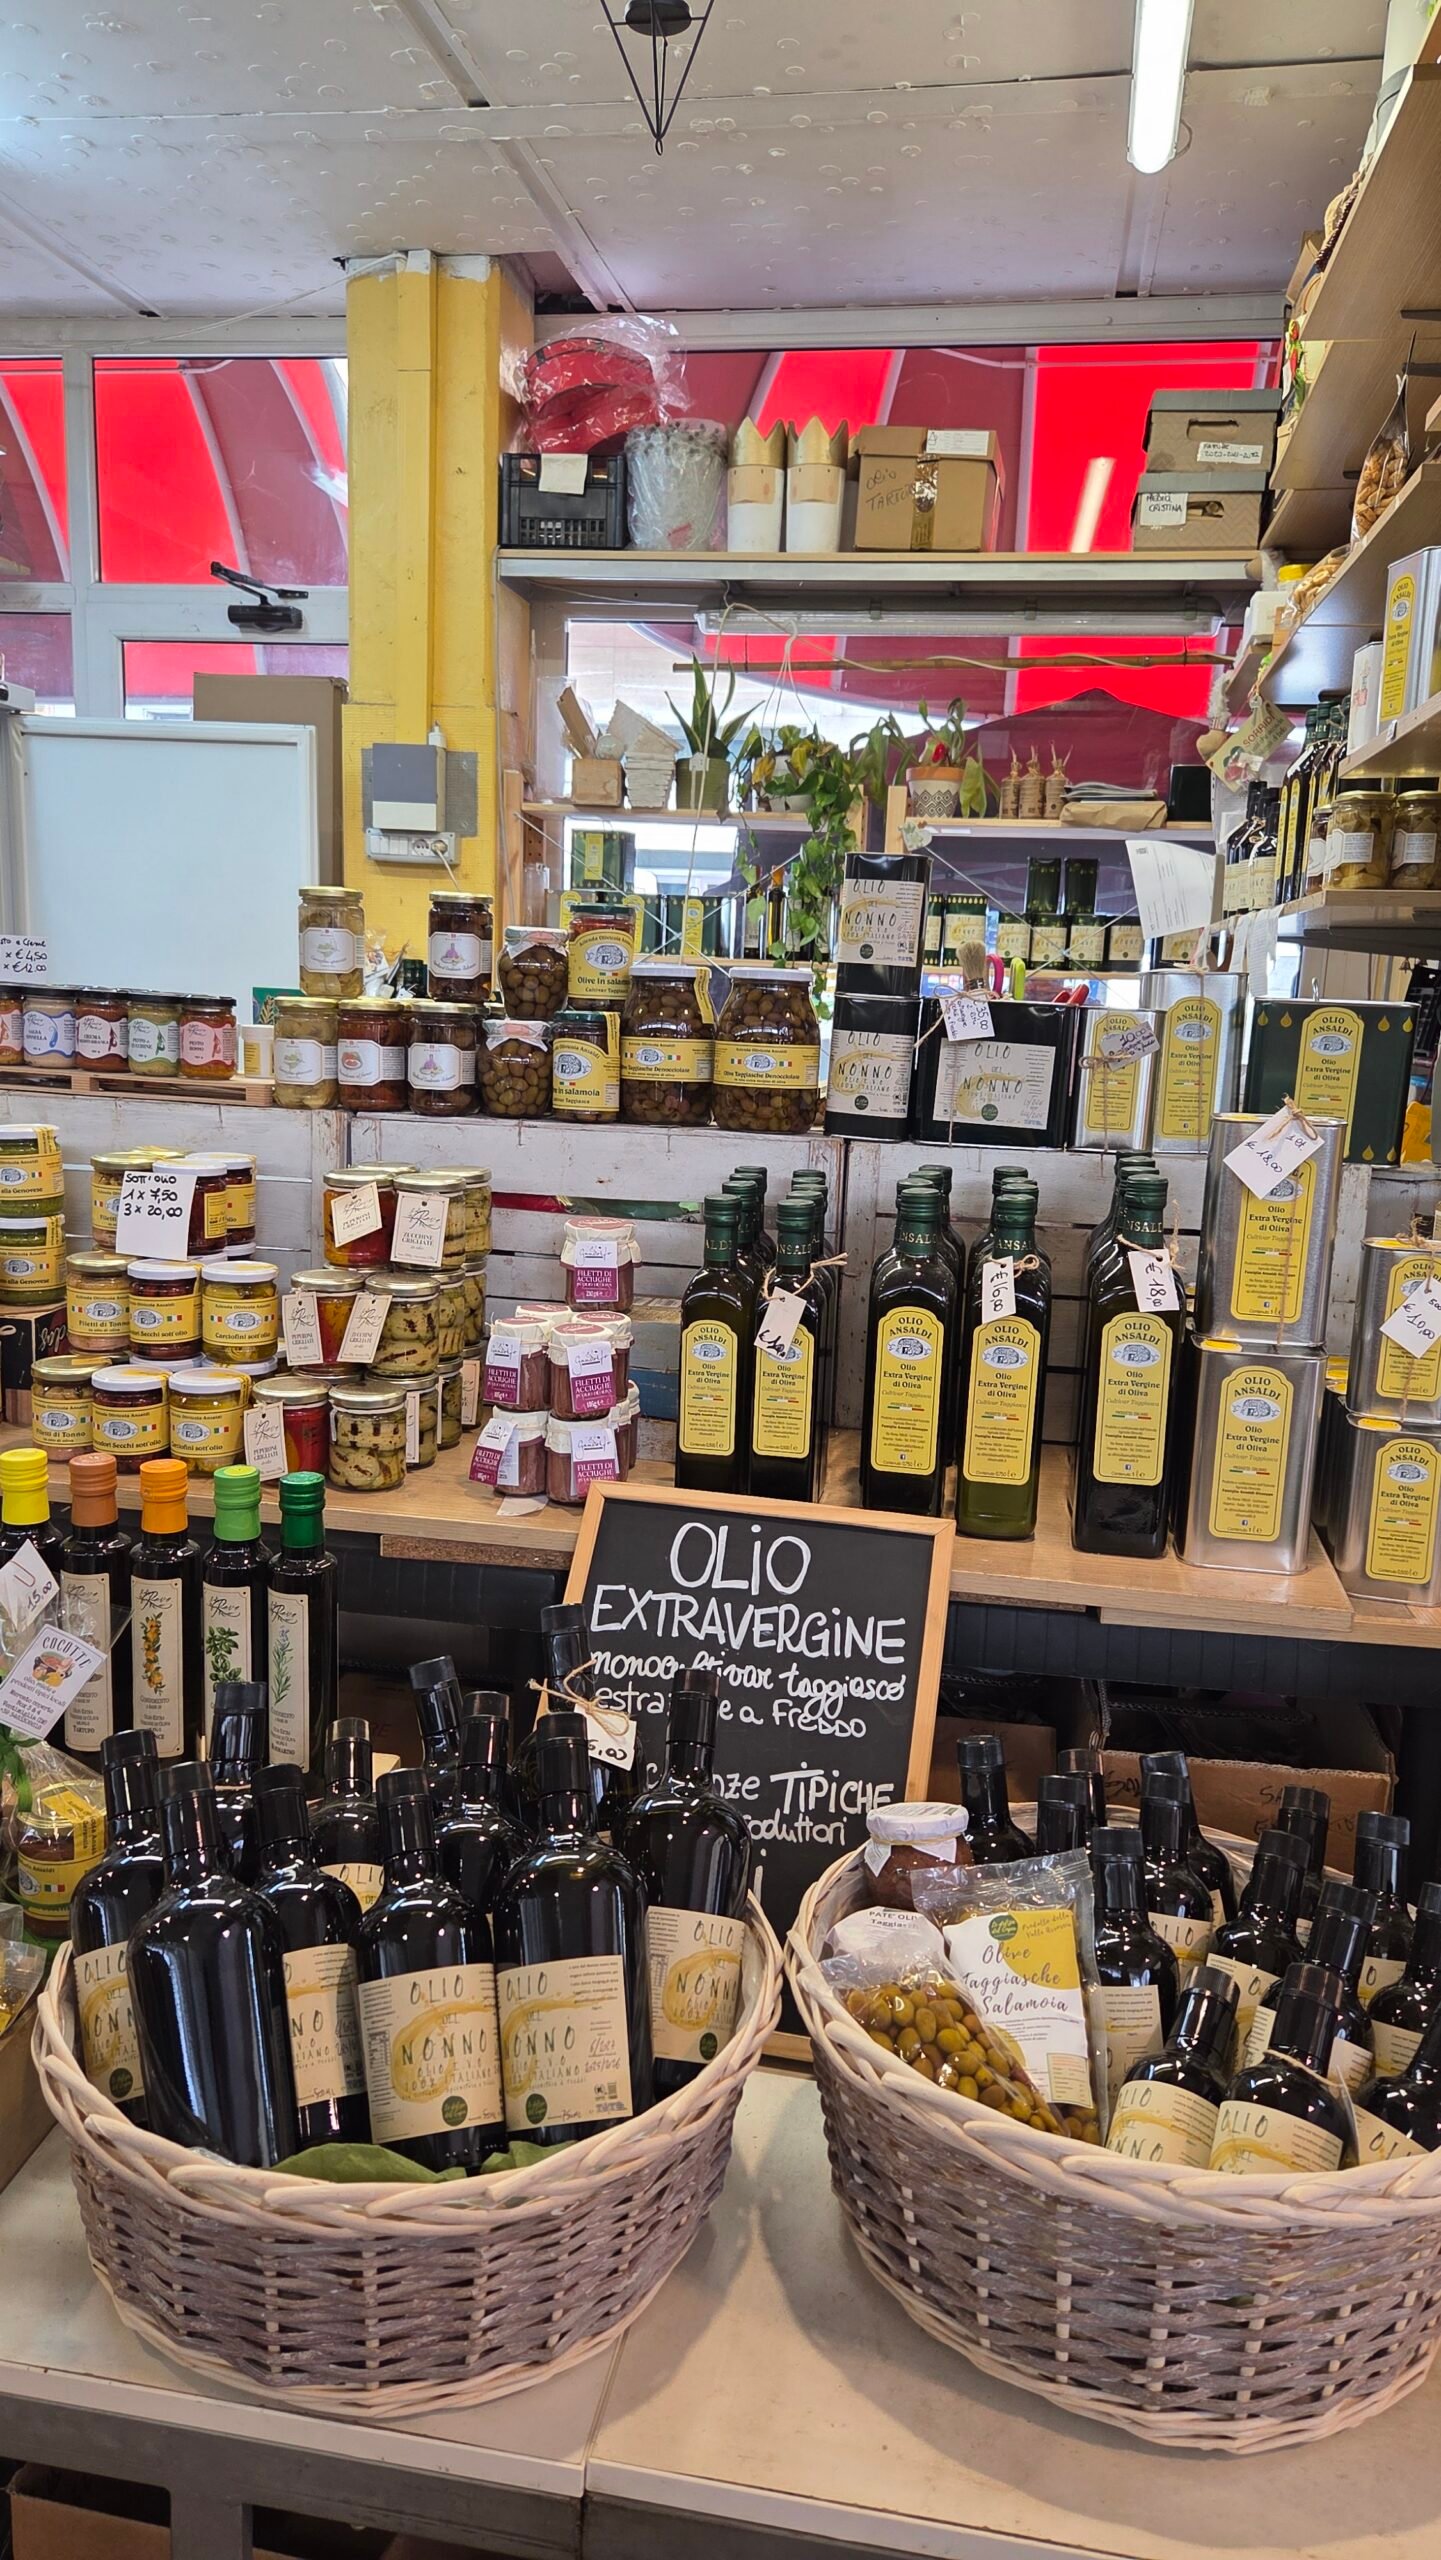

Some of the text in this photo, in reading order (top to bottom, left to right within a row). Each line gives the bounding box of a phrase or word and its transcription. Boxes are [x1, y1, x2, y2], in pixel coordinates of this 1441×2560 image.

[853, 880, 885, 894] OLIO
[845, 912, 897, 926] NONNO
[578, 977, 595, 985] Olive
[1176, 1012, 1213, 1023] ANSALDI
[1313, 1025, 1353, 1036] ANSALDI
[848, 1031, 880, 1047] OLIO
[975, 1043, 1011, 1059] OLIO
[839, 1062, 892, 1080] NONNO
[963, 1077, 1023, 1094] NONNO
[564, 1088, 600, 1096] salamoia
[150, 1188, 178, 1203] 7,50
[124, 1203, 132, 1216] 3
[147, 1205, 183, 1220] 20,00
[1249, 1214, 1303, 1224] Extra Vergine
[898, 1316, 923, 1325] OLIO
[700, 1327, 719, 1335] OLIO
[995, 1326, 1020, 1335] OLIO
[1124, 1322, 1151, 1331] OLIO
[889, 1326, 933, 1339] ANSALDI
[693, 1335, 727, 1345] ANSALDI
[985, 1336, 1029, 1348] ANSALDI
[1114, 1332, 1161, 1345] ANSALDI
[488, 1368, 508, 1378] FILETTI
[705, 1371, 730, 1379] Vergine
[780, 1373, 805, 1381] Vergine
[883, 1371, 932, 1382] Extra Vergine
[1126, 1370, 1143, 1378] Olio
[488, 1376, 515, 1384] ACCIUGHE
[575, 1378, 600, 1387] FILETTI
[1108, 1379, 1160, 1390] Extra Vergine
[1244, 1377, 1271, 1386] OLIO
[576, 1383, 611, 1393] ACCIUGHE
[902, 1382, 921, 1390] Oliva
[978, 1381, 1028, 1392] Extra Vergine
[997, 1391, 1017, 1399] Oliva
[1127, 1389, 1148, 1397] Oliva
[1234, 1387, 1281, 1400] ANSALDI
[62, 1430, 86, 1438] Tonno
[1226, 1433, 1280, 1445] Extra Vergine
[113, 1441, 135, 1449] Secchi
[1247, 1445, 1268, 1453] Oliva
[1398, 1446, 1421, 1454] OLIO
[1390, 1454, 1429, 1466] ANSALDI
[577, 1463, 603, 1471] FILETTI
[1381, 1491, 1430, 1501] Extra Vergine
[42, 1635, 92, 1669] COCOTTE
[740, 1706, 764, 1726] a
[744, 1813, 848, 1847] oduttori
[694, 1920, 733, 1947] OLIO
[982, 1942, 1031, 1964] Olive
[963, 1963, 1061, 1995] Taggiasche
[410, 1974, 464, 2005] OLIO
[506, 1971, 548, 2001] OLIO
[983, 1992, 1069, 2016] Salamoia
[402, 2029, 487, 2065] NONNO
[514, 2026, 576, 2058] ONNO
[1221, 2109, 1268, 2138] OLIO
